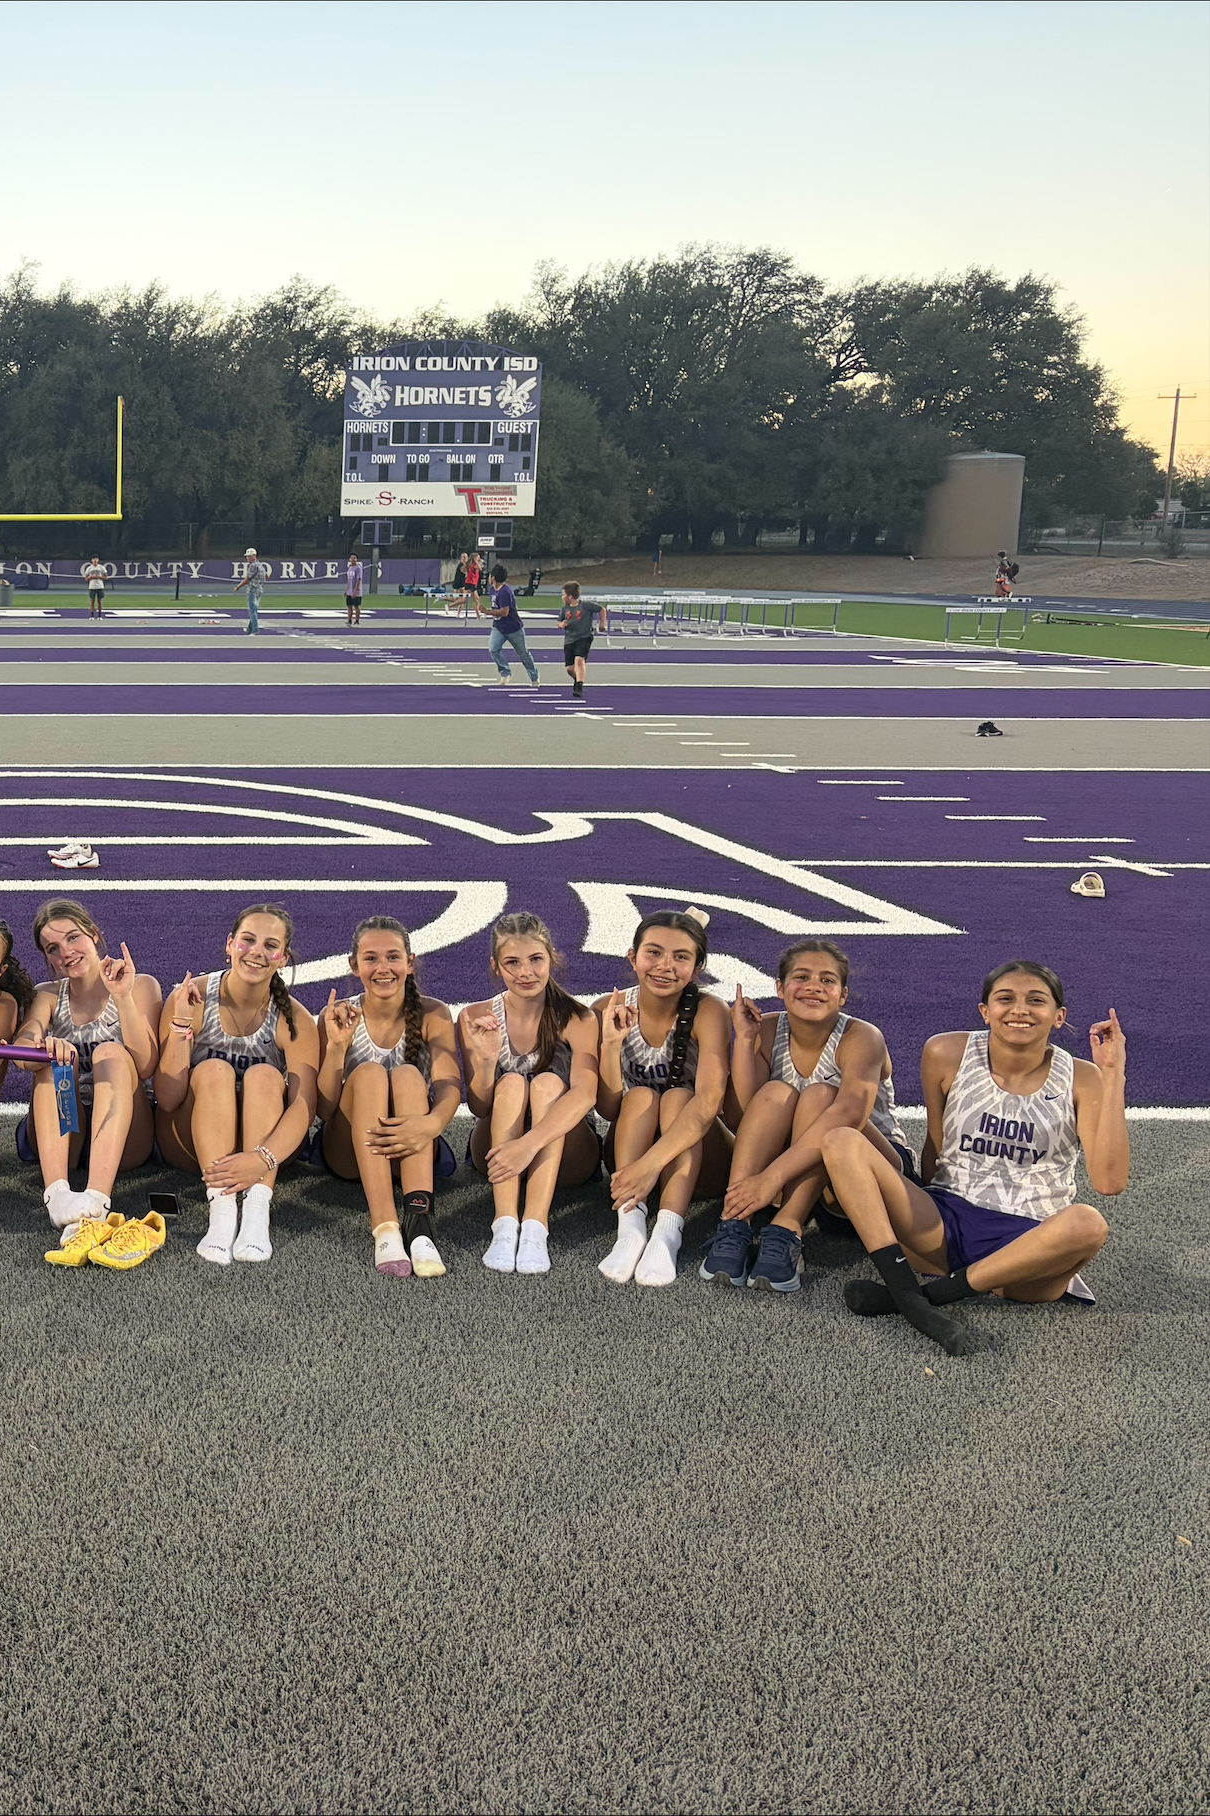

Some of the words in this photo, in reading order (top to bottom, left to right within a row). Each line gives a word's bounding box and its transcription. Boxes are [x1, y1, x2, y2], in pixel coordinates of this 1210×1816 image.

[352, 356, 410, 371] IRION
[415, 356, 499, 371] COUNTY
[503, 356, 538, 371] ISD
[394, 385, 492, 407] HORNETS
[346, 422, 389, 434] HORNETS
[497, 422, 533, 434] GUEST
[371, 454, 396, 464] DOWN
[407, 454, 417, 464] TO
[418, 454, 430, 464] GO
[446, 454, 465, 464] BALL
[465, 454, 476, 464] ON
[488, 454, 504, 464] QTR
[346, 473, 365, 482] T.O.L.
[513, 472, 533, 482] T.O.L.
[629, 1060, 668, 1079] IRIO
[978, 1112, 1035, 1143] IRION
[959, 1133, 1047, 1165] COUNTY
